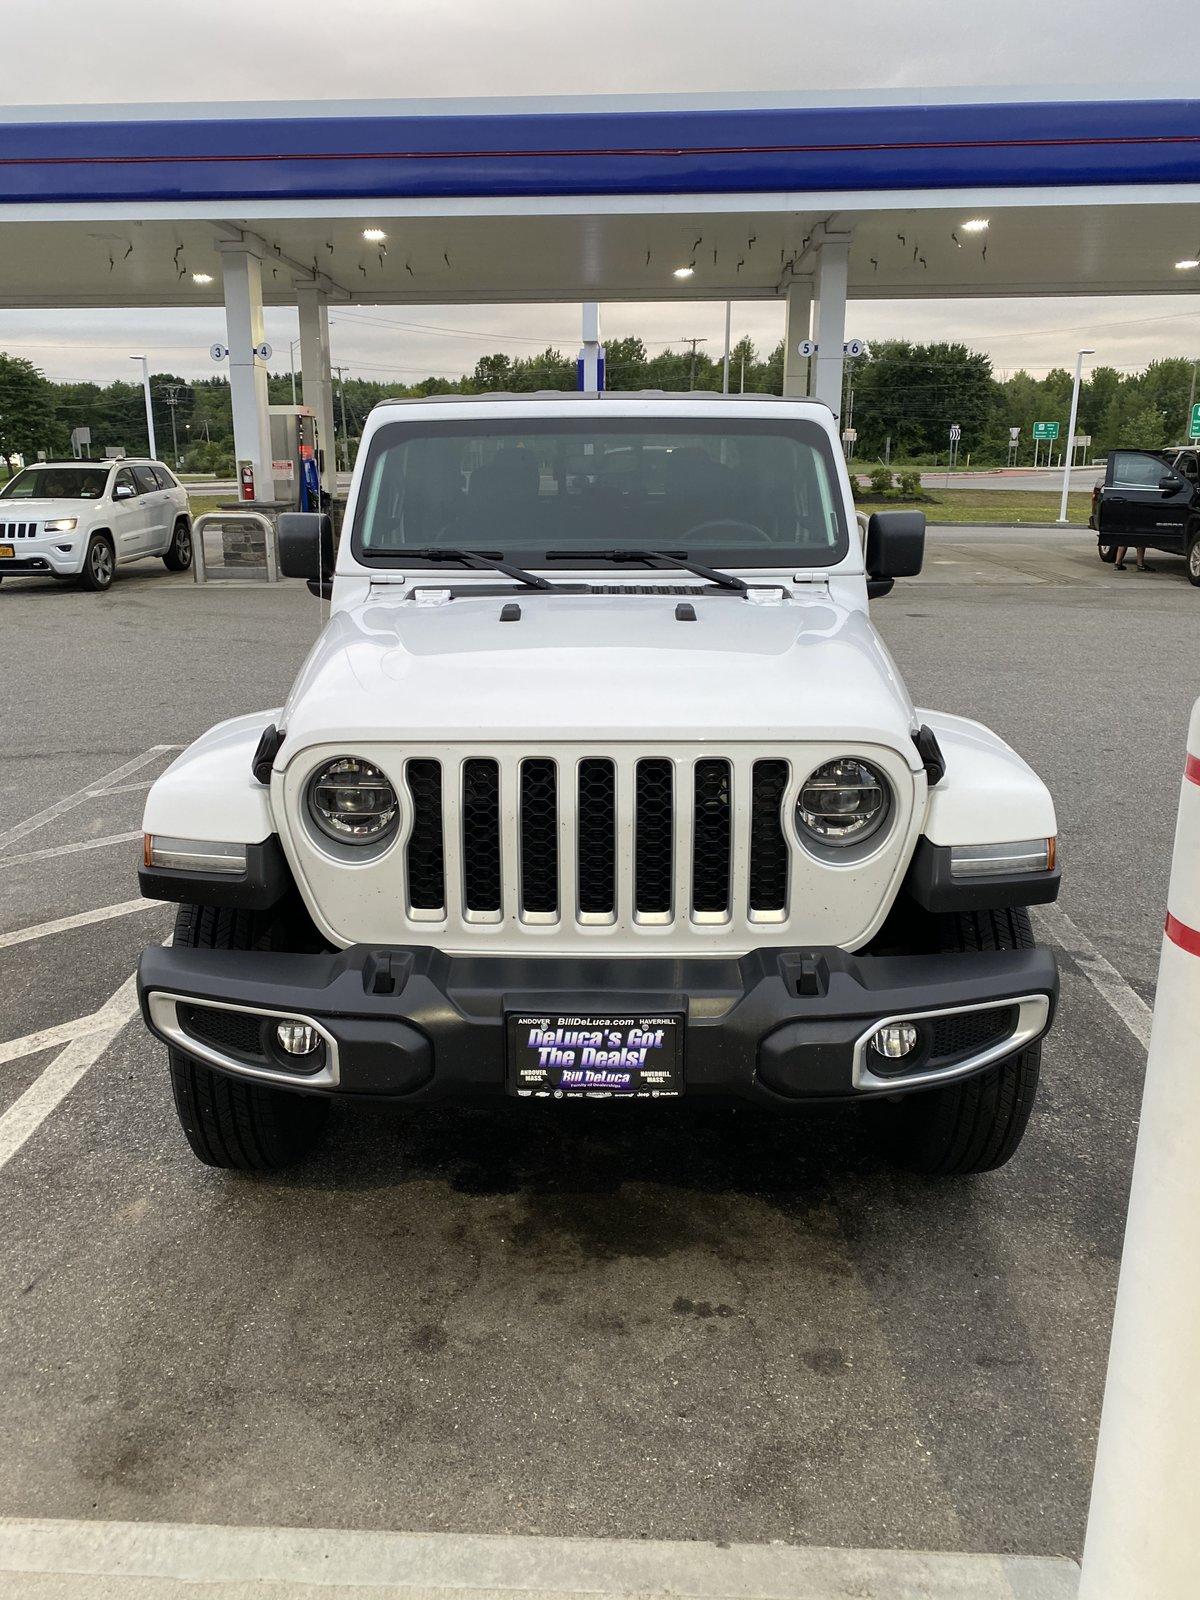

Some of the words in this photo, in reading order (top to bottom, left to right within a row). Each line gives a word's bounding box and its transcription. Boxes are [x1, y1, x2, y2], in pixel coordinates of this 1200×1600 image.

[215, 347, 221, 358] 3
[261, 346, 267, 357] 4
[803, 343, 809, 354] 5
[852, 343, 858, 354] 6
[557, 1017, 634, 1026] BillDeLuca.com
[528, 1028, 622, 1048] DeLuca's
[626, 1028, 665, 1049] Got
[538, 1046, 576, 1068] The
[580, 1047, 648, 1069] Deals!
[562, 1070, 584, 1082] Bill
[585, 1070, 630, 1083] DeLuca
